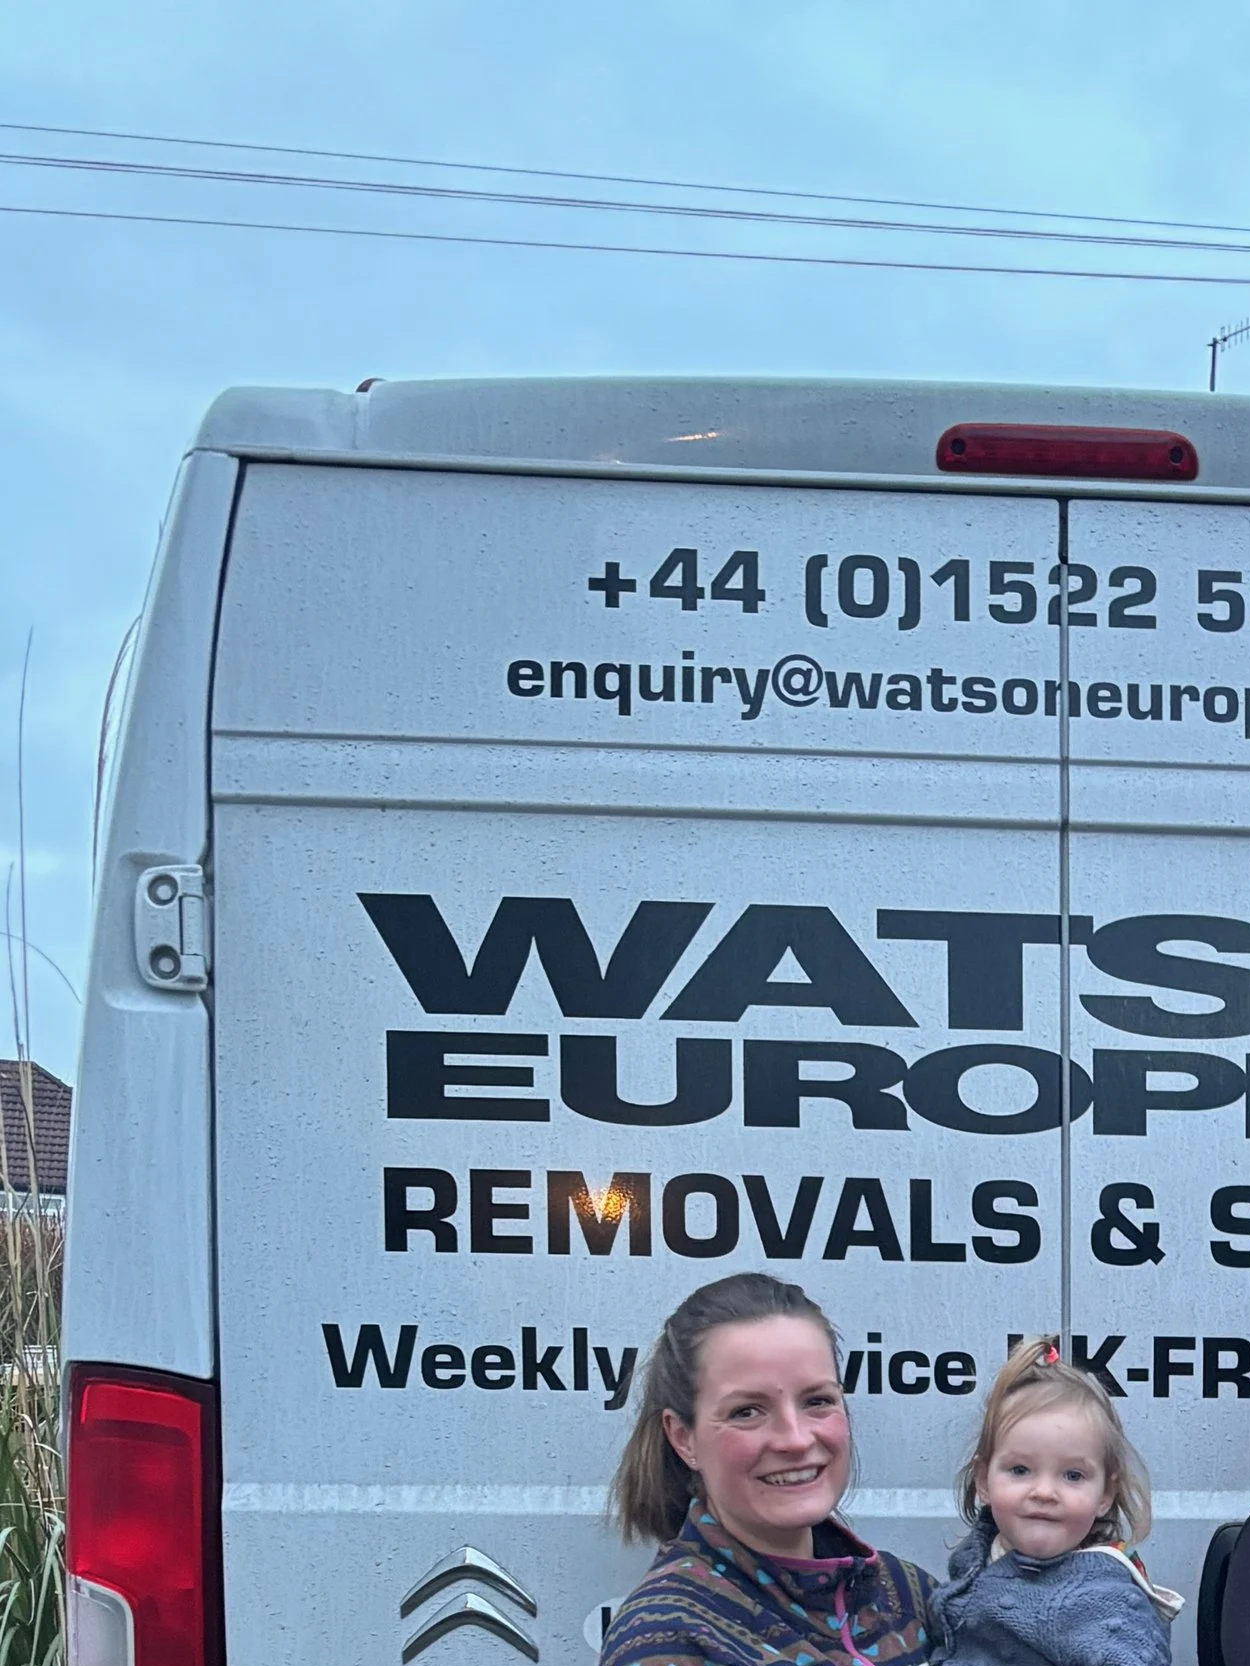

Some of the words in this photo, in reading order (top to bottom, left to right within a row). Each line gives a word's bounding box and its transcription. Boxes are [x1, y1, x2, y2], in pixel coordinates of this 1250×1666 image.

[588, 548, 765, 614] +44
[805, 553, 1157, 630] (0)1522
[383, 1166, 1042, 1264] REMOVALS
[1090, 1182, 1167, 1266] &
[321, 1323, 638, 1410] Weekly
[842, 1332, 977, 1396] vice
